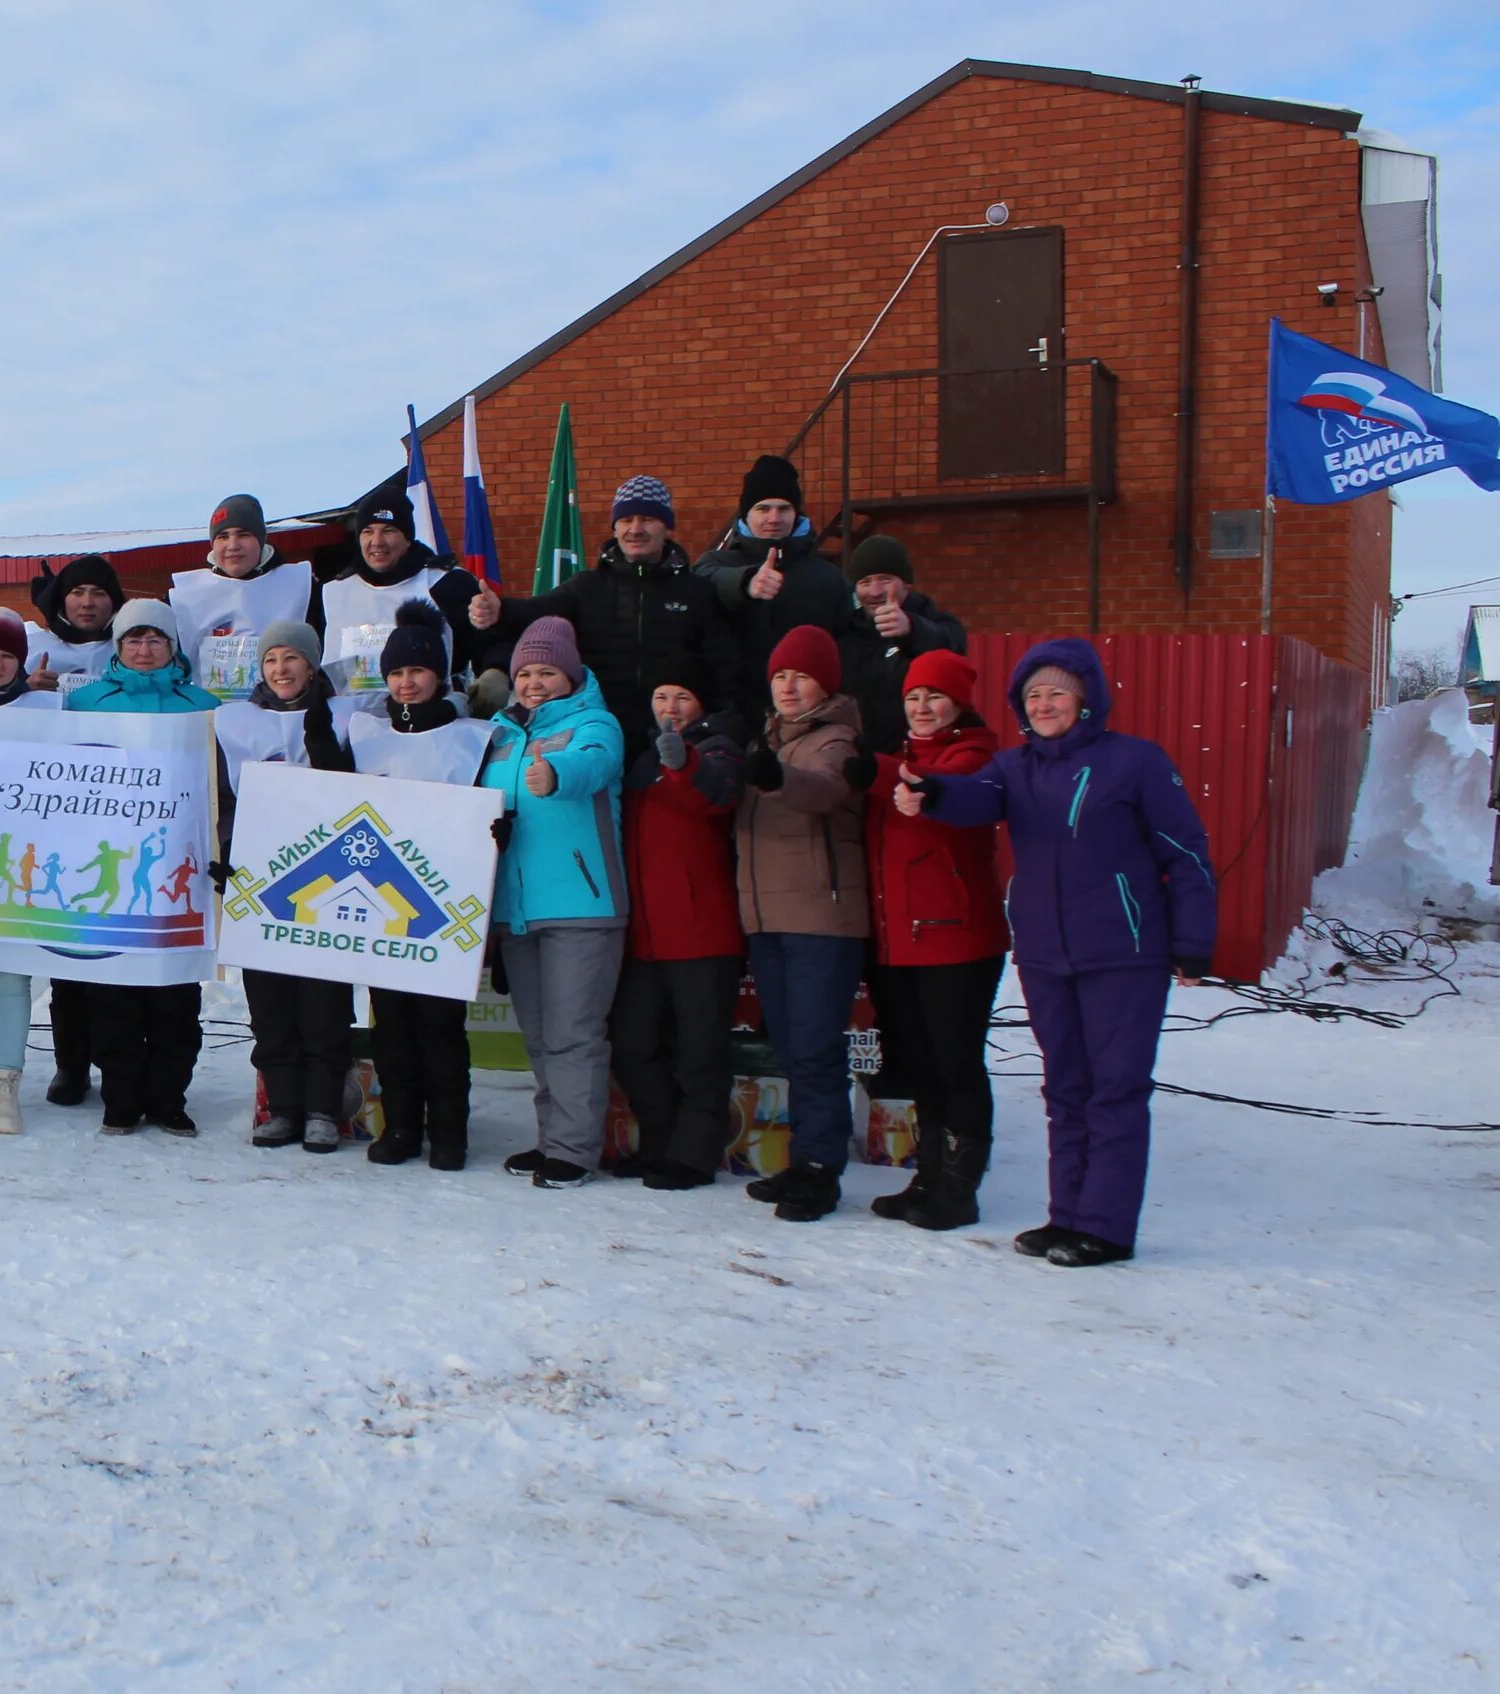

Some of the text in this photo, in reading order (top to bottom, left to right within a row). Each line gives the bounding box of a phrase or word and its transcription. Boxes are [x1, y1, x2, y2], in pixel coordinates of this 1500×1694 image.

[1330, 444, 1446, 494] РОССИЯ
[26, 759, 162, 789] команда
[267, 823, 451, 896] АЙЫҠ АУЫЛ
[261, 923, 438, 963] ТРЕЗВОЕ СЕЛО
[467, 1001, 511, 1022] ЕКТ
